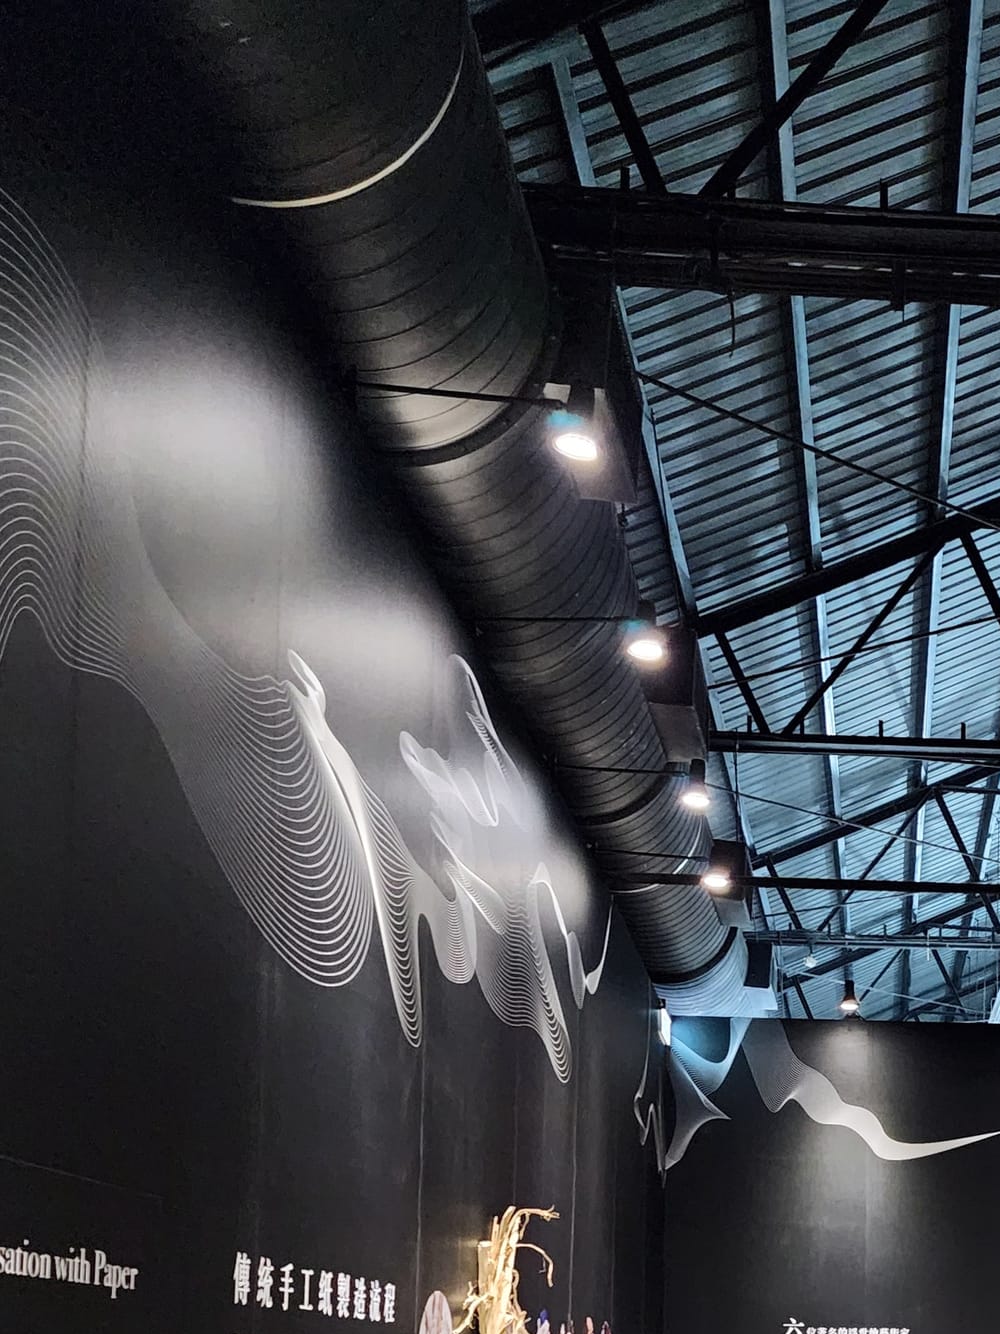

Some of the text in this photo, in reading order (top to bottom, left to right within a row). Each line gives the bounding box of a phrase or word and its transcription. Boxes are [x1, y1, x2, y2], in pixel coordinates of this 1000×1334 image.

[54, 1247, 90, 1284] with
[94, 1250, 138, 1298] Paper
[234, 1252, 395, 1323] 傳統手工紙製造流程
